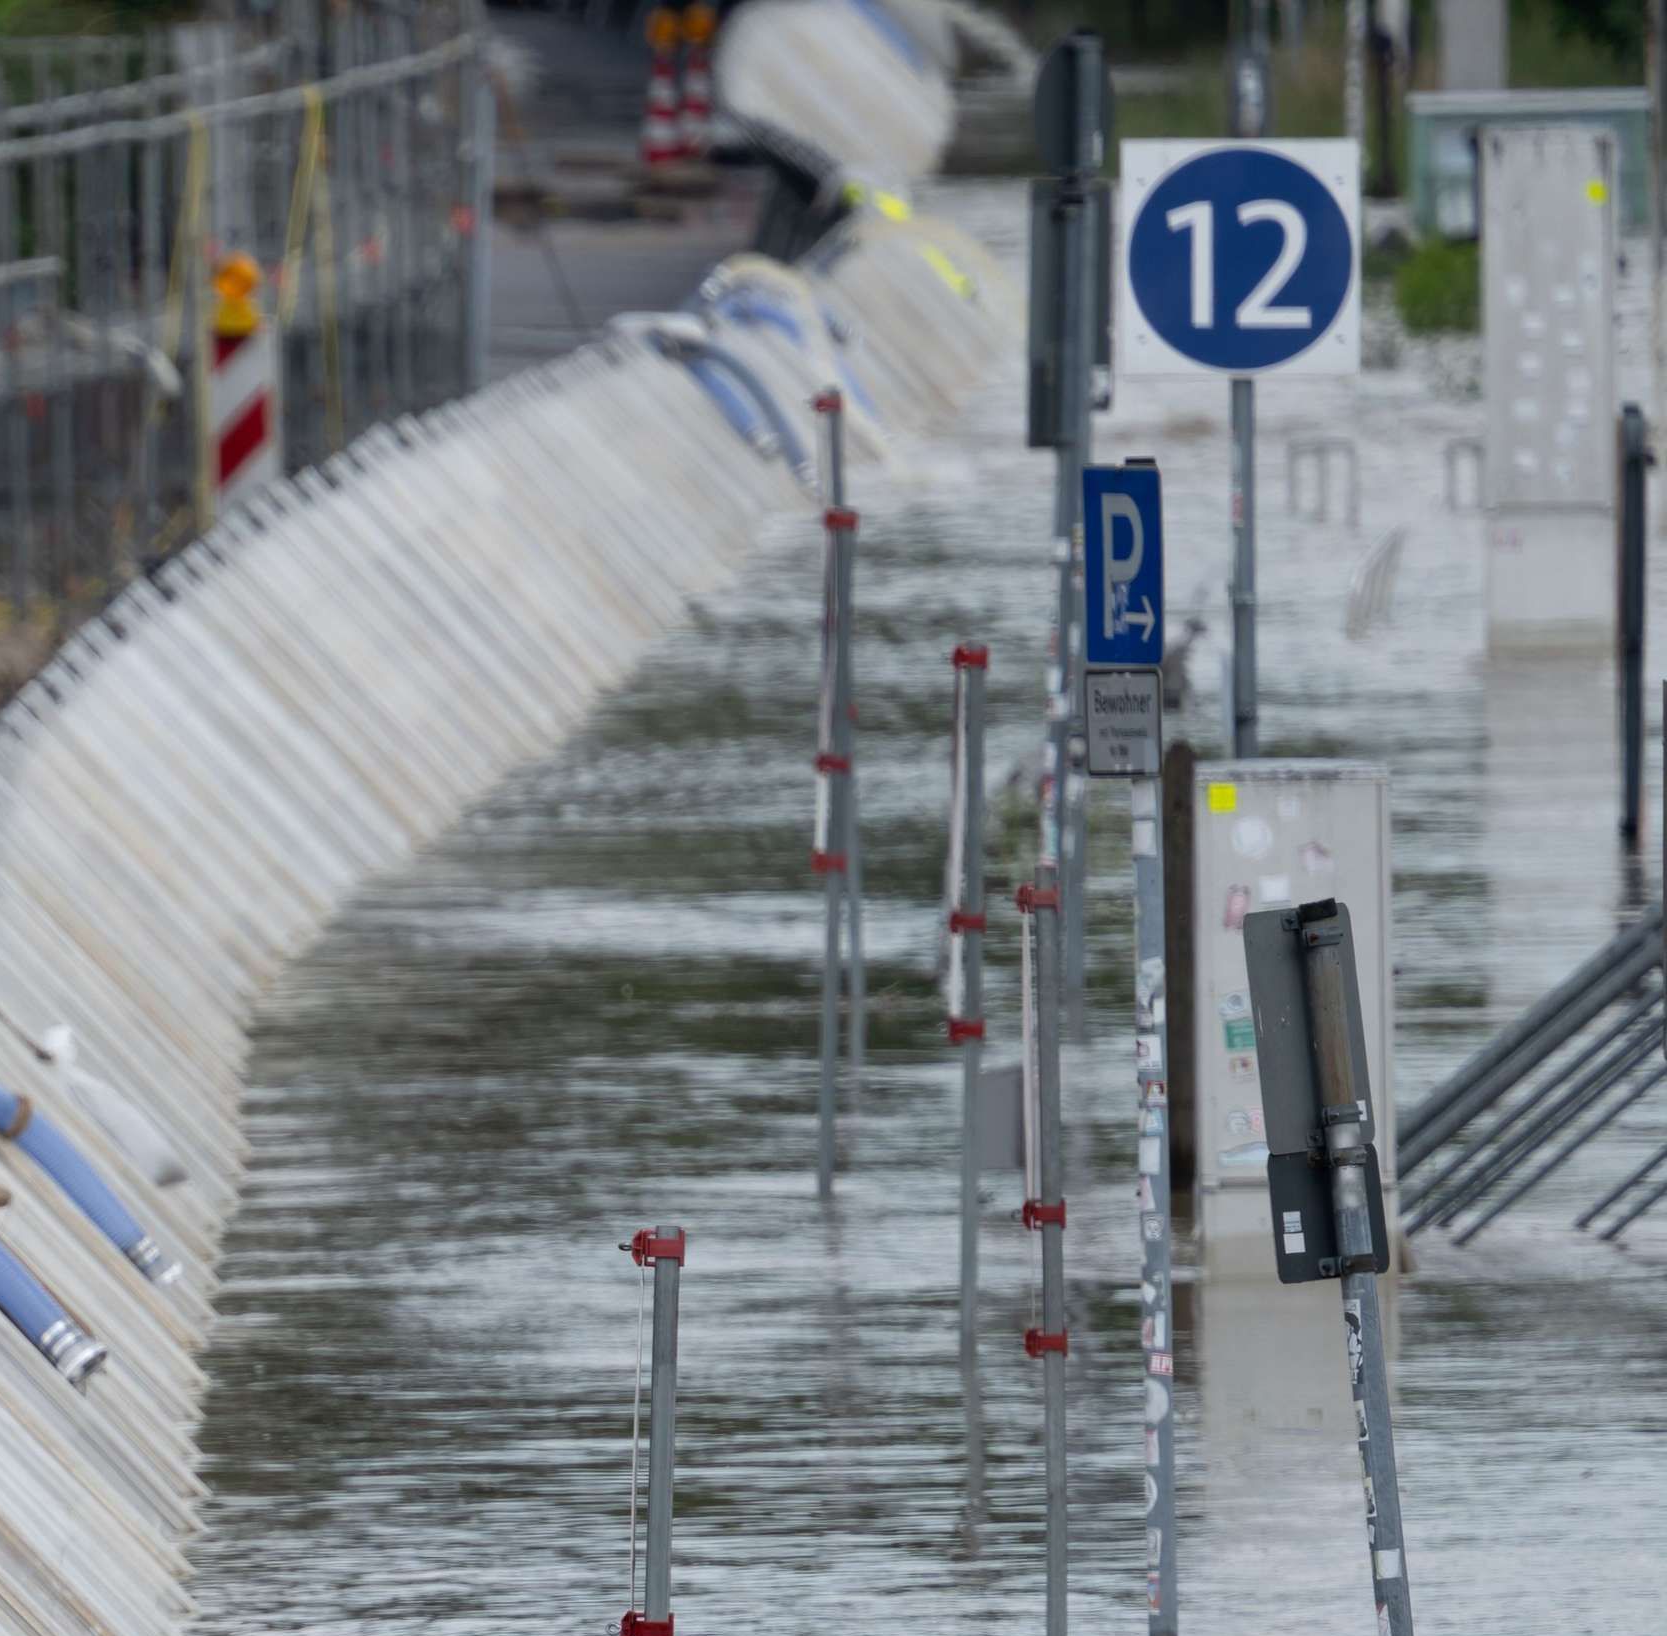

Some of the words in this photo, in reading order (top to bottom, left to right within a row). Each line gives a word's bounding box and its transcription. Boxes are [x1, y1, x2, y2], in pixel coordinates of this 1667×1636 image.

[1166, 198, 1313, 330] 12
[1100, 493, 1145, 639] P
[1094, 687, 1152, 714] Bewohner
